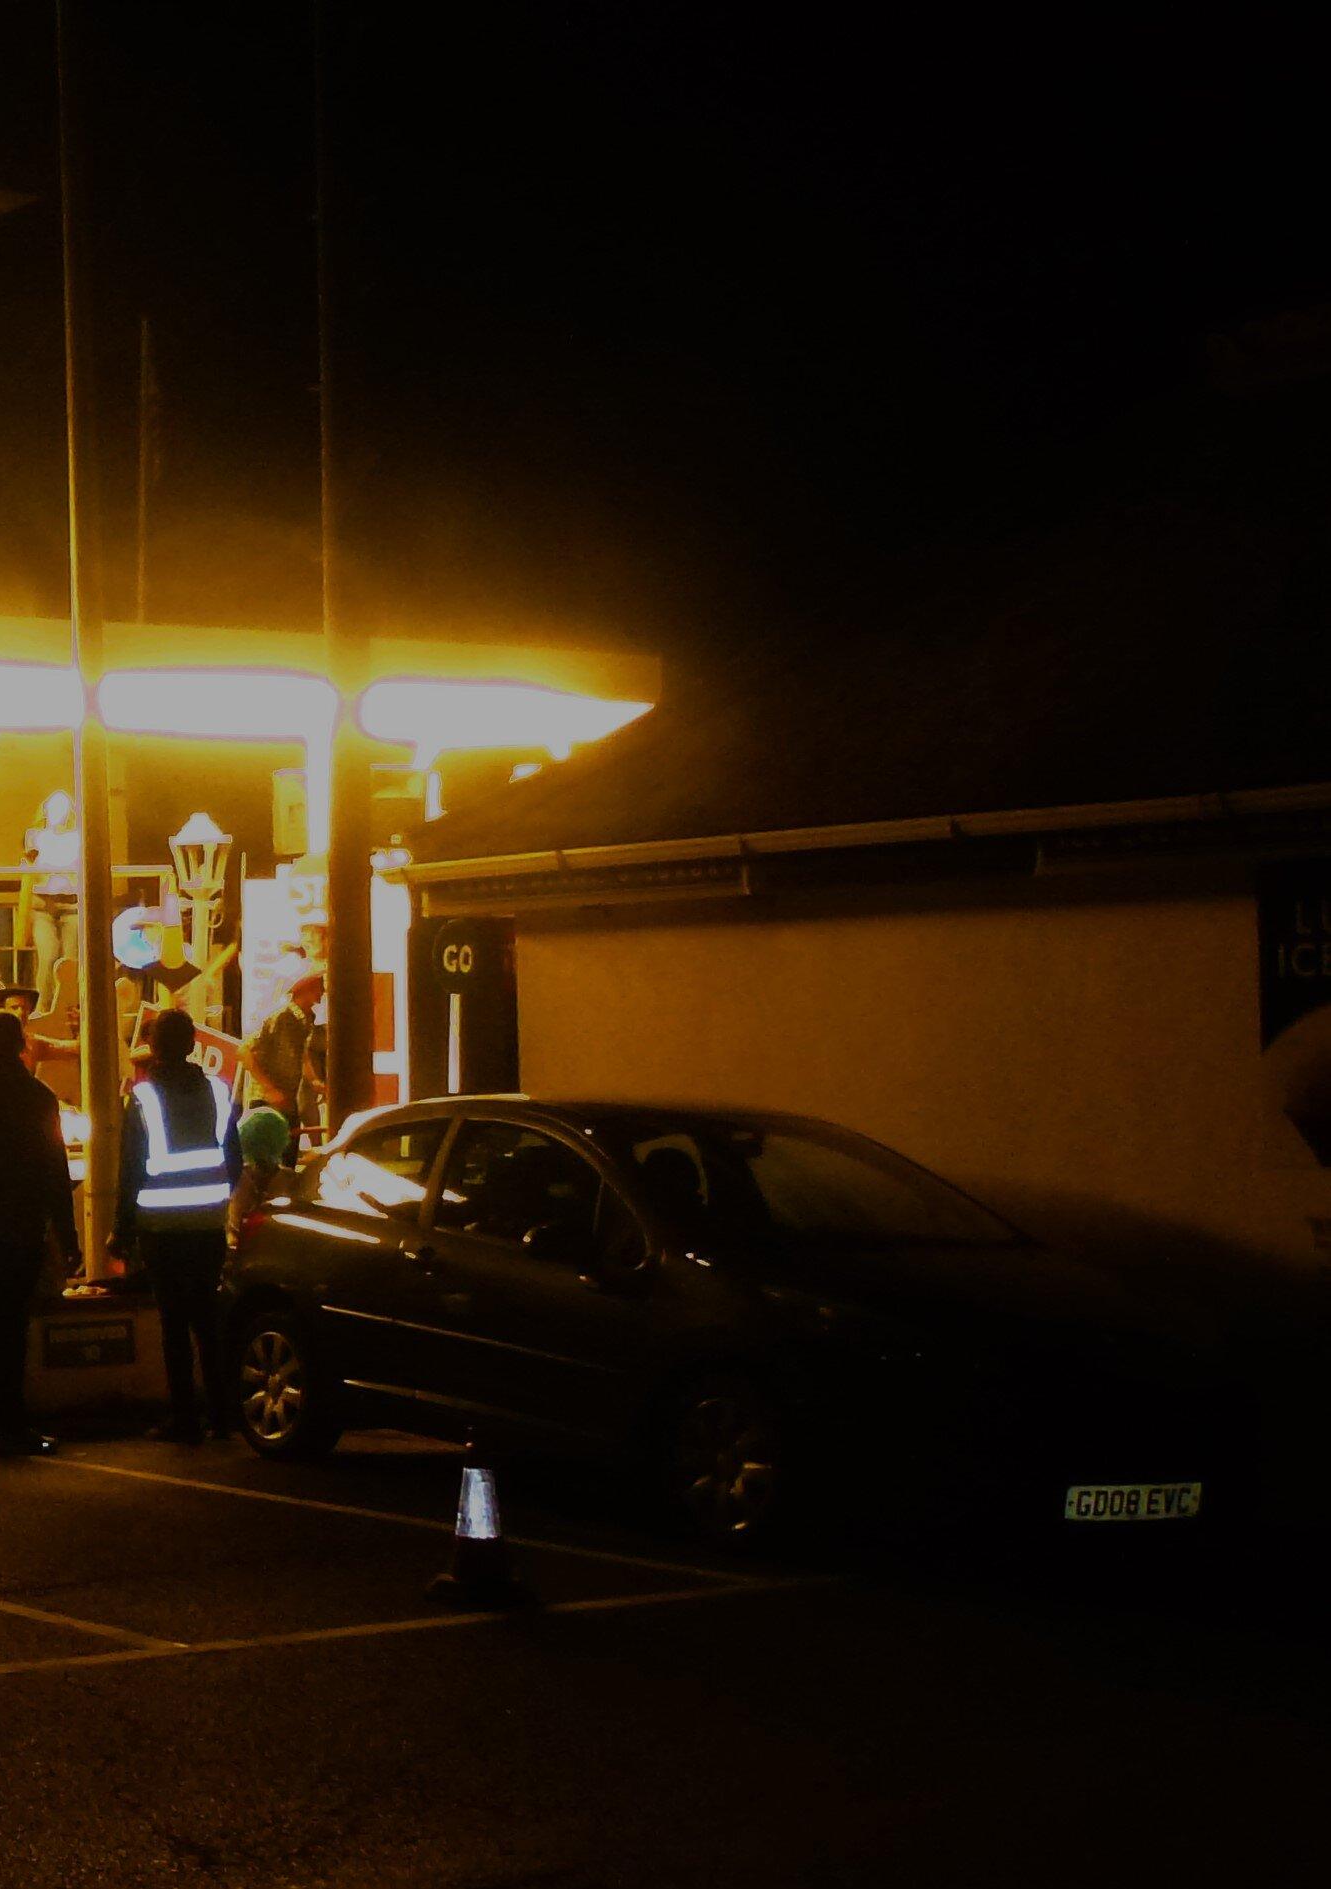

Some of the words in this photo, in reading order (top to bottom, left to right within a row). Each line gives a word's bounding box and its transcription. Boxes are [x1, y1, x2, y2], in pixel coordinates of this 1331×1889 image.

[443, 945, 472, 973] GO
[1076, 1490, 1141, 1516] GD08
[1147, 1487, 1192, 1516] EVC
